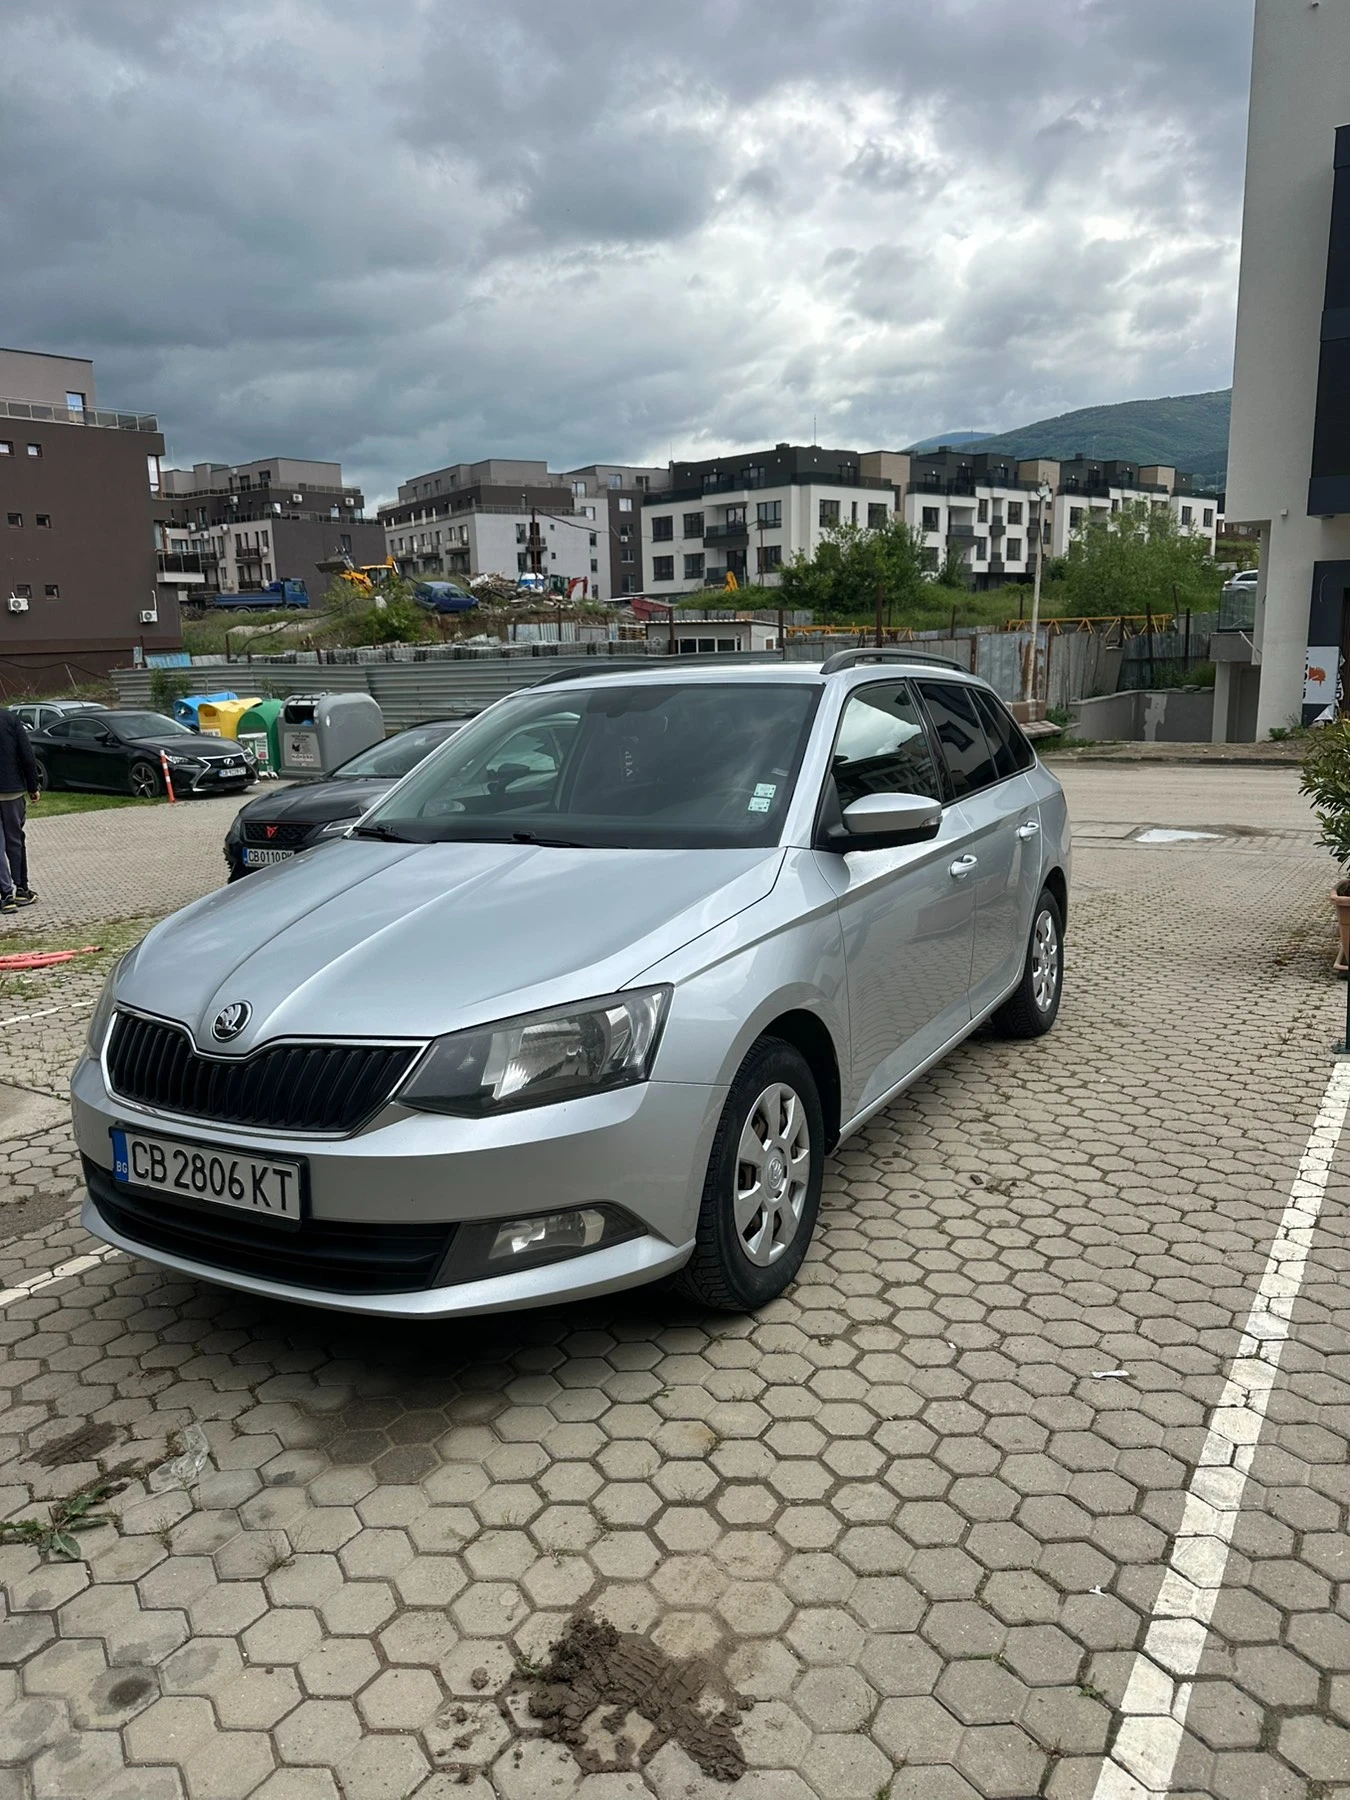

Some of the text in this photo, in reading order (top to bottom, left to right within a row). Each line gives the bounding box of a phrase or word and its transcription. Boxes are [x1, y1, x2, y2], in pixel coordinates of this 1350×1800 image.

[248, 850, 260, 862] CB
[260, 851, 280, 862] 0110
[116, 1160, 128, 1173] BG
[131, 1140, 293, 1211] CB 2806 KT
